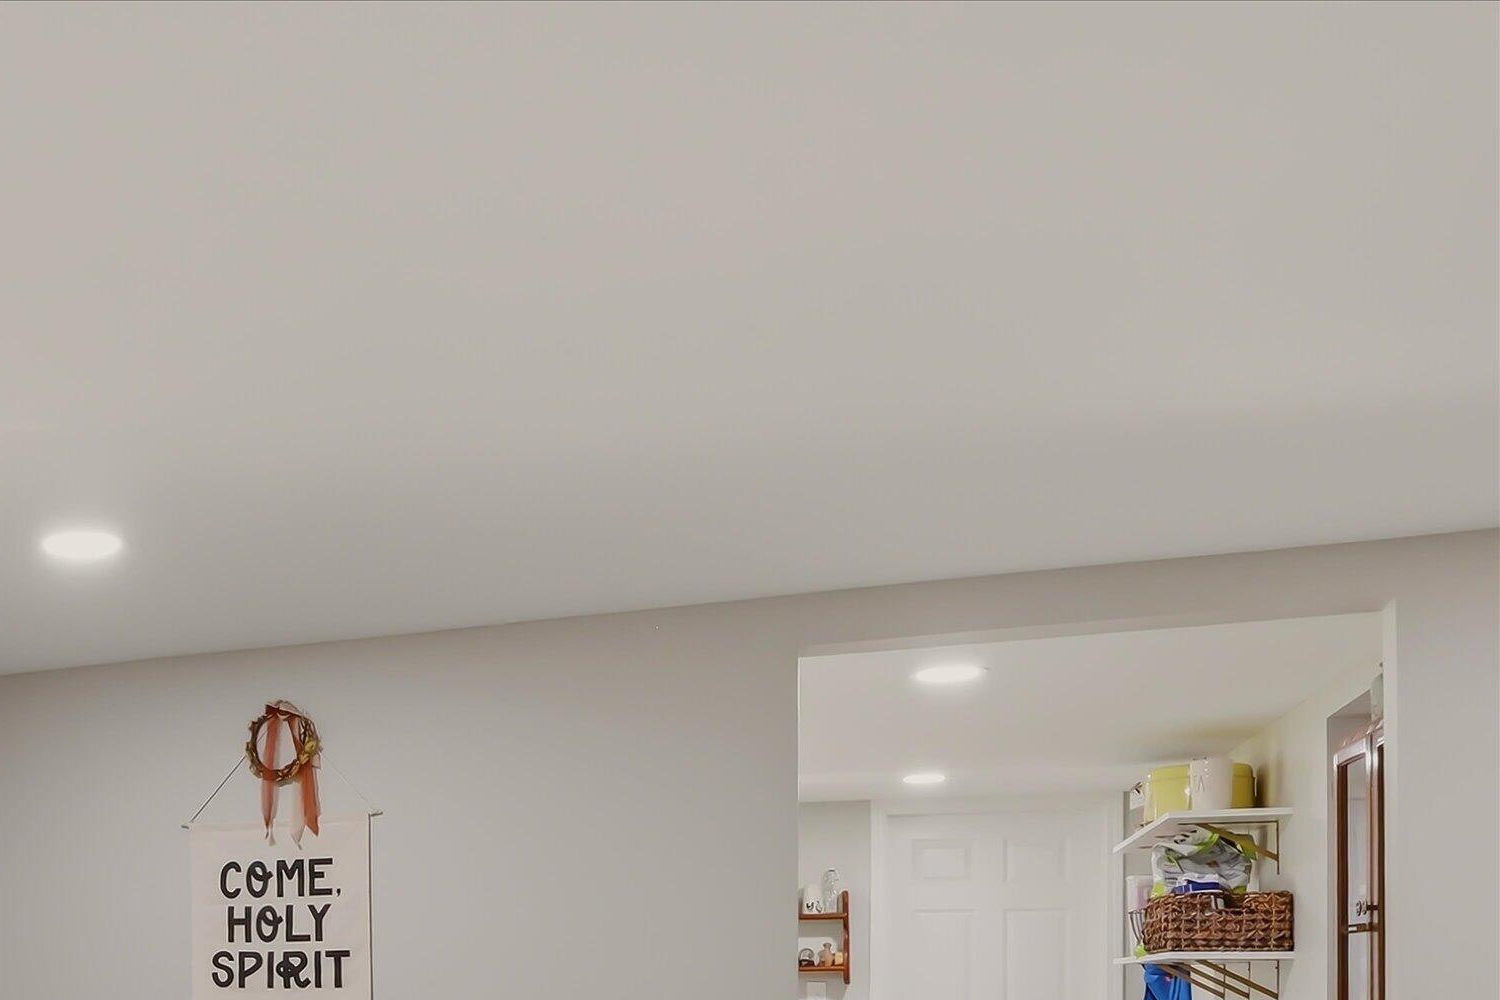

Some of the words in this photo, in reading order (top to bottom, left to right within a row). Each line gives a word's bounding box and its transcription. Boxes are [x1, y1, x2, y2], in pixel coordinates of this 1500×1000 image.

[220, 858, 341, 899] COME,
[227, 903, 332, 943] HOLY
[211, 950, 351, 989] SPIRIT
